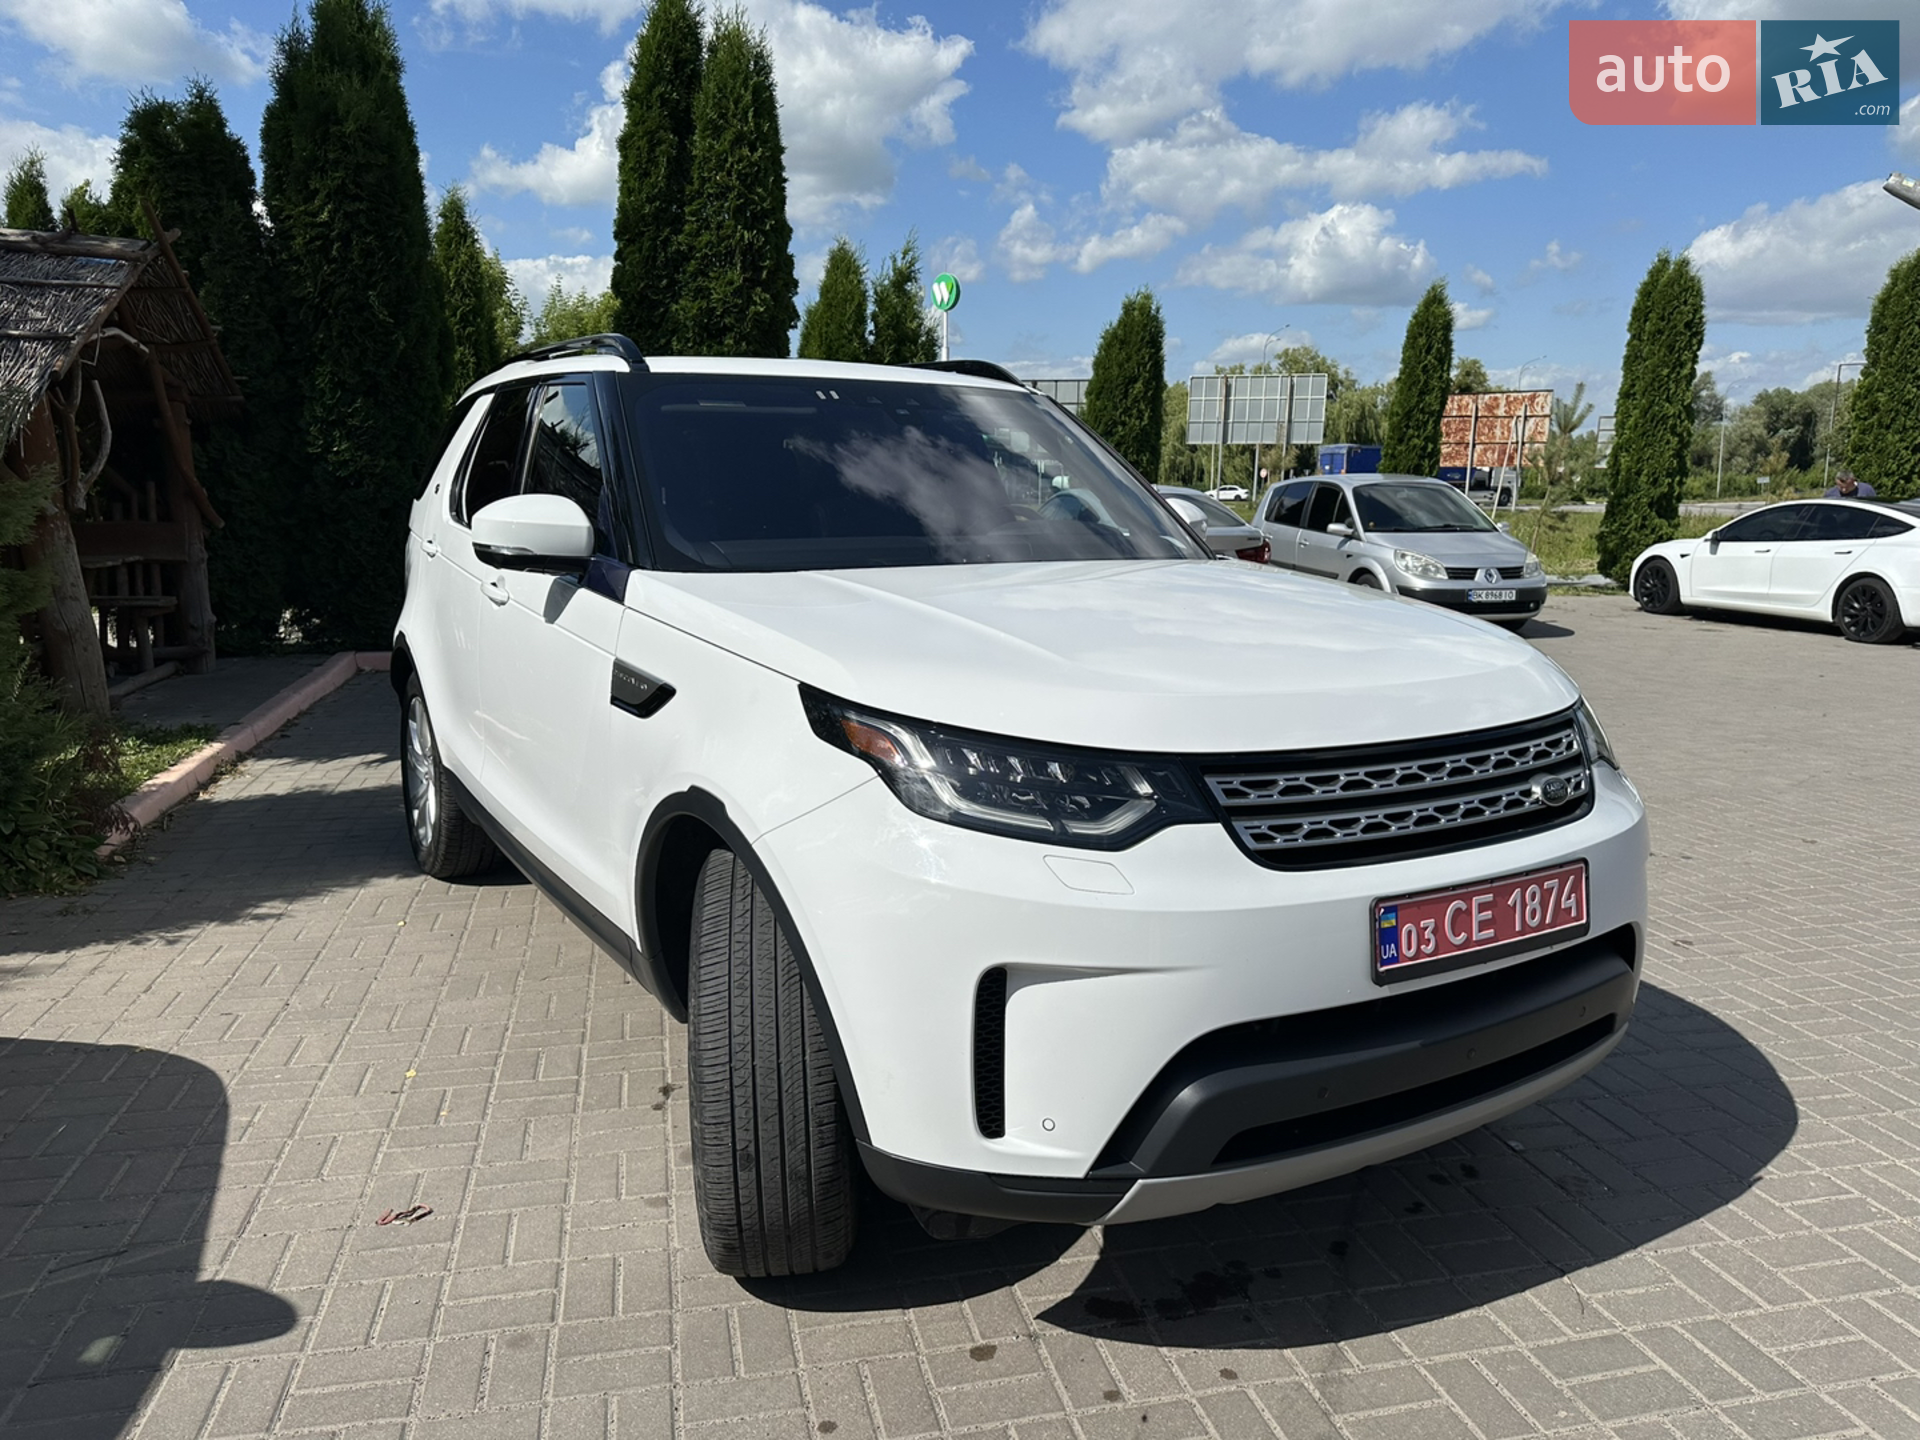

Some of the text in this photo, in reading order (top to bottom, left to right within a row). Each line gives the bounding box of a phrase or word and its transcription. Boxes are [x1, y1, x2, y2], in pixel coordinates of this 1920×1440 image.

[1402, 875, 1576, 958] 03 CE 1874
[1381, 943, 1397, 959] UA
